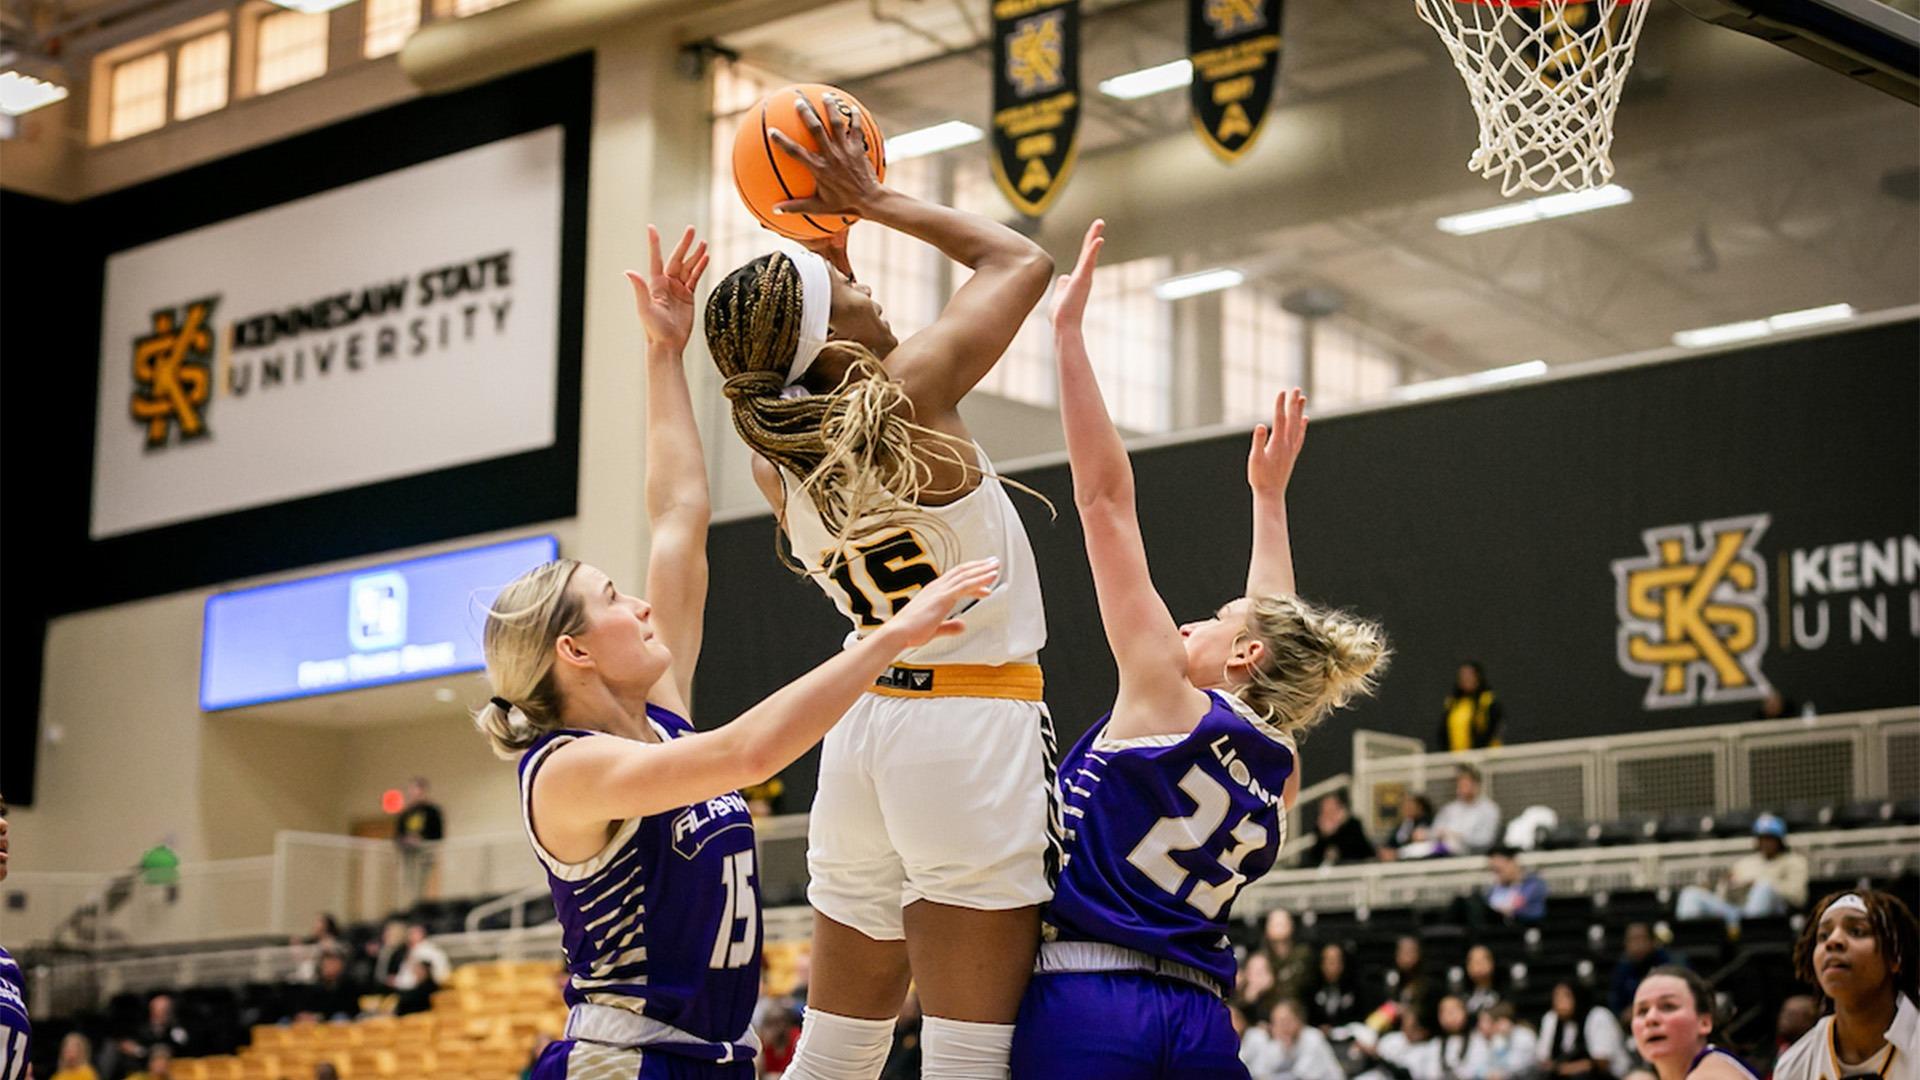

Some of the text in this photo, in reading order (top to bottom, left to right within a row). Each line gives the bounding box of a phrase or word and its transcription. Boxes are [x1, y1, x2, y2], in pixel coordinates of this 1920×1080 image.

[229, 300, 512, 396] UNIVERSITY
[233, 250, 512, 349] KENNESAW STATE
[820, 528, 941, 628] 15
[1126, 762, 1268, 920] 23
[708, 849, 757, 969] 15
